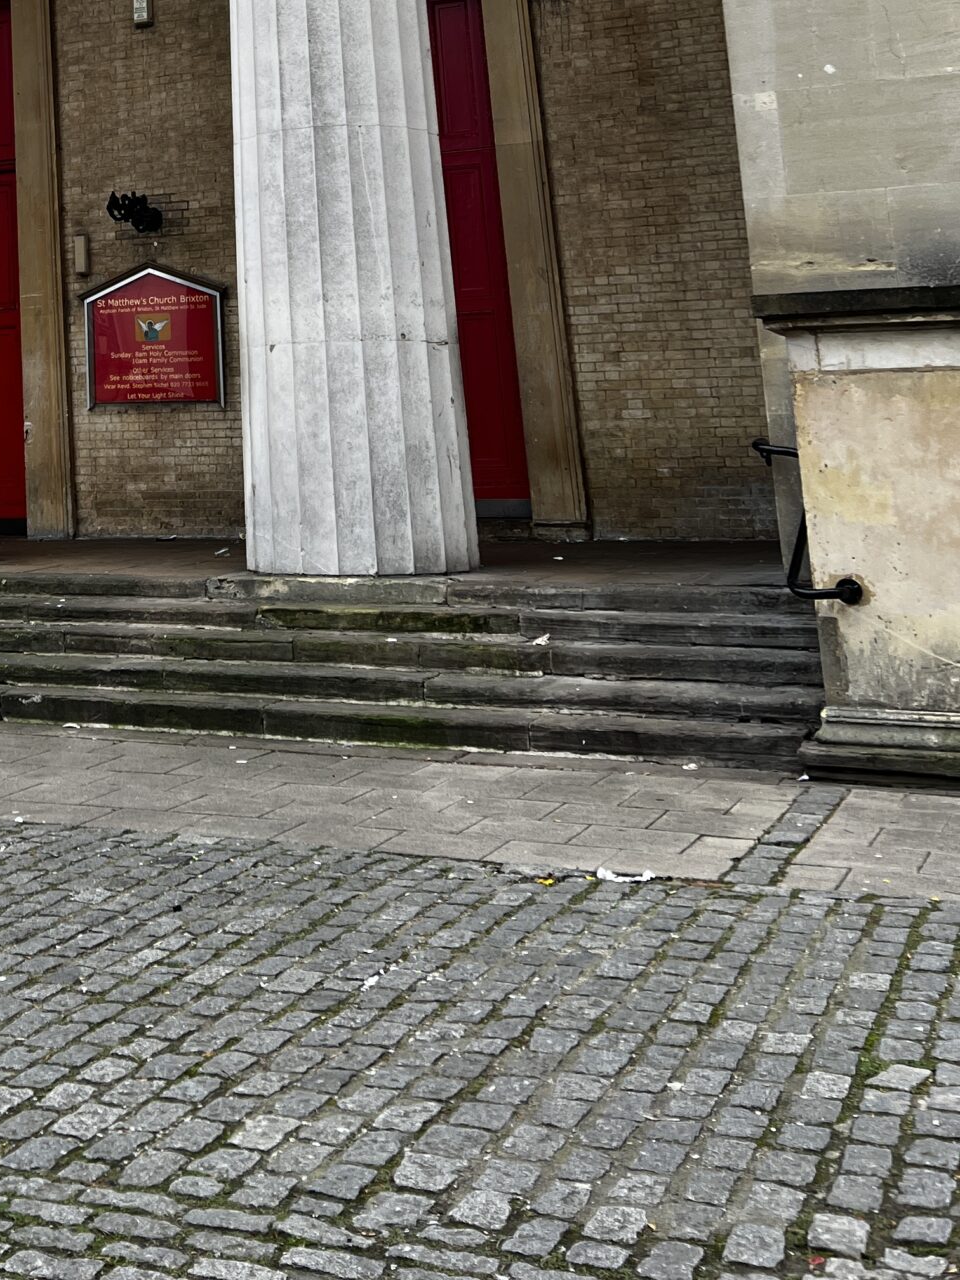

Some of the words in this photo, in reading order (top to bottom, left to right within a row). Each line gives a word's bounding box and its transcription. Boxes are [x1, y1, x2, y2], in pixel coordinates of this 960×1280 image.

[97, 299, 105, 308] St
[108, 297, 146, 307] Matthew's
[148, 295, 177, 305] Church
[180, 294, 209, 303] Brixton
[151, 391, 166, 399] Light
[168, 391, 184, 399] Shine
